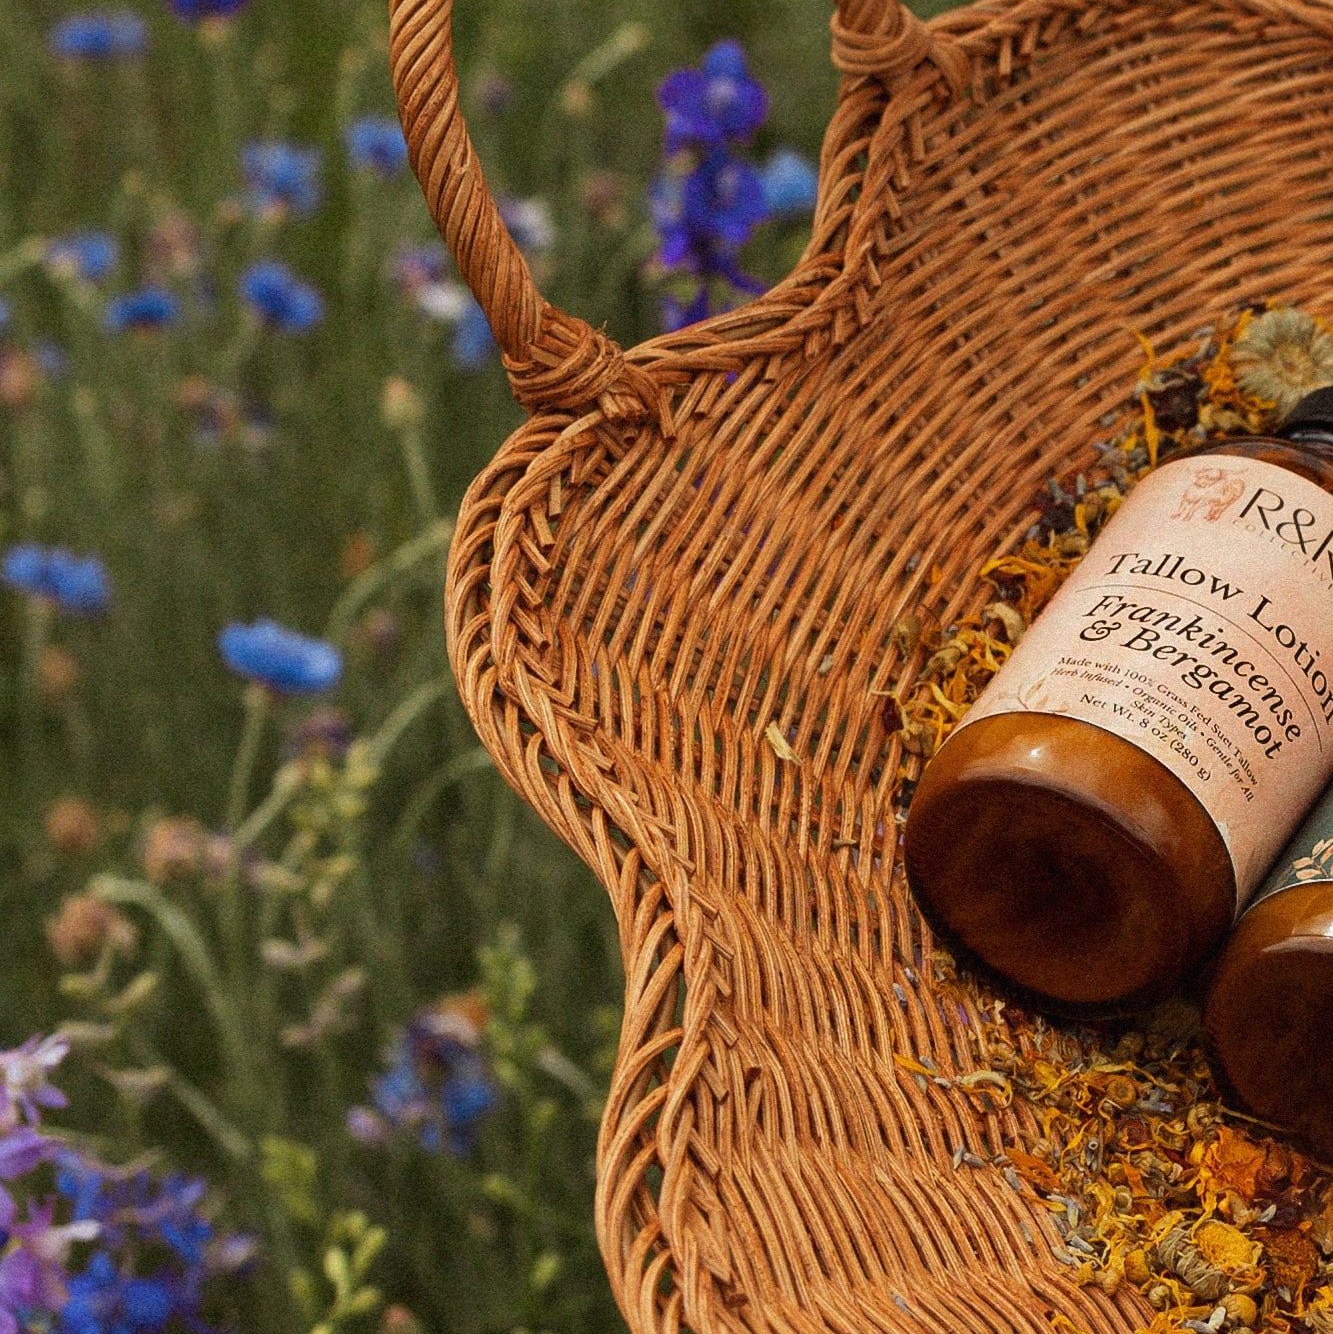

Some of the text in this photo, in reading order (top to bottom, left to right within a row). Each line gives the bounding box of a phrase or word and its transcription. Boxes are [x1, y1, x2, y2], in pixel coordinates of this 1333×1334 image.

[1105, 553, 1243, 600] Tallow
[1058, 657, 1258, 785] Made with 100% Grass Fed Suet Tallow
[1079, 620, 1283, 759] & Bergamot
[1082, 595, 1300, 742] Frankincense
[1130, 700, 1187, 740] Skin Types
[1050, 668, 1255, 802] Herb Infused Organic Oils Gentle for All
[1080, 694, 1106, 708] Net
[1139, 718, 1150, 728] 8
[1151, 727, 1168, 742] oz
[1170, 739, 1199, 766] (280
[1197, 767, 1211, 782] g)
